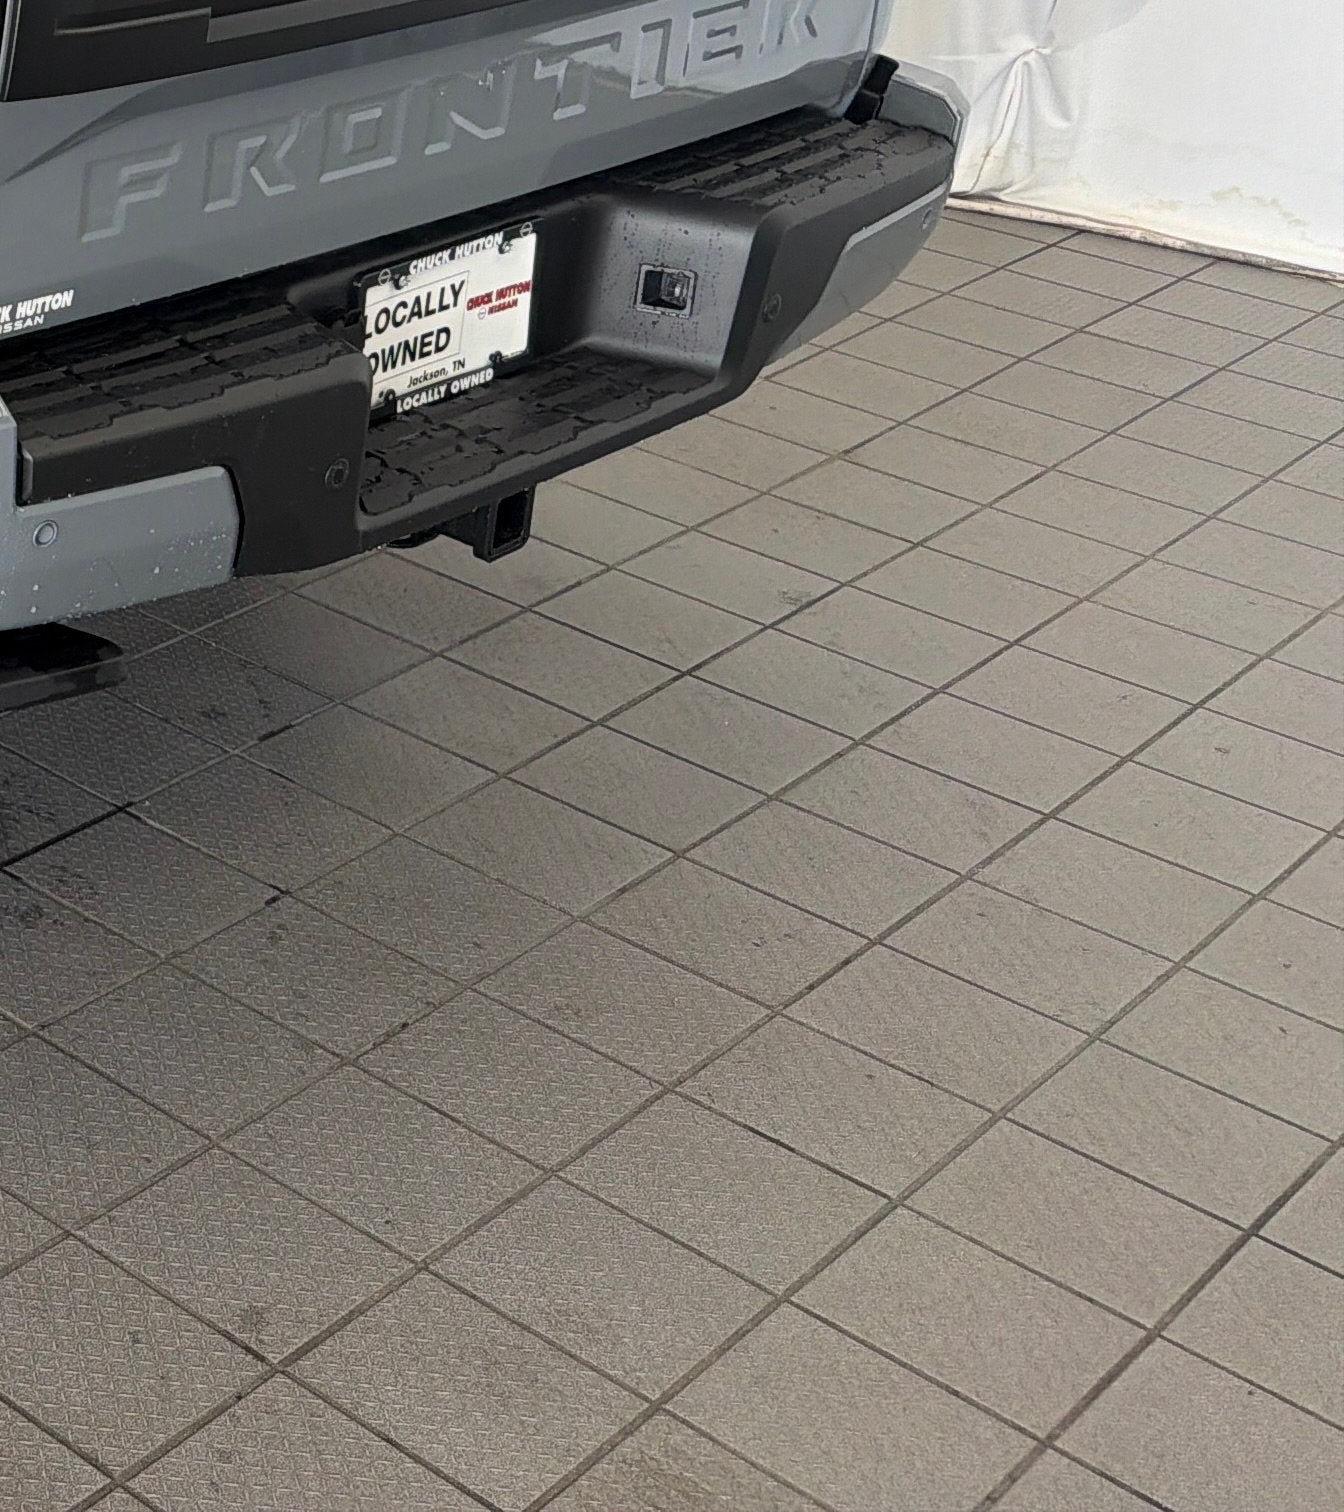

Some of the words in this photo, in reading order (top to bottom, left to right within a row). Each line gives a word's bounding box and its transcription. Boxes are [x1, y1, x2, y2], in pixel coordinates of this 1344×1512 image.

[408, 249, 452, 275] CHUCK
[454, 231, 505, 261] HUTTON
[15, 289, 75, 320] HUTTON
[365, 279, 466, 340] LOCALLY
[466, 290, 494, 312] CHUCK
[495, 279, 533, 302] HUTTON
[396, 383, 448, 414] LOCALLY
[450, 368, 494, 395] OWNED
[407, 367, 449, 389] Jackson,
[452, 358, 466, 372] TN
